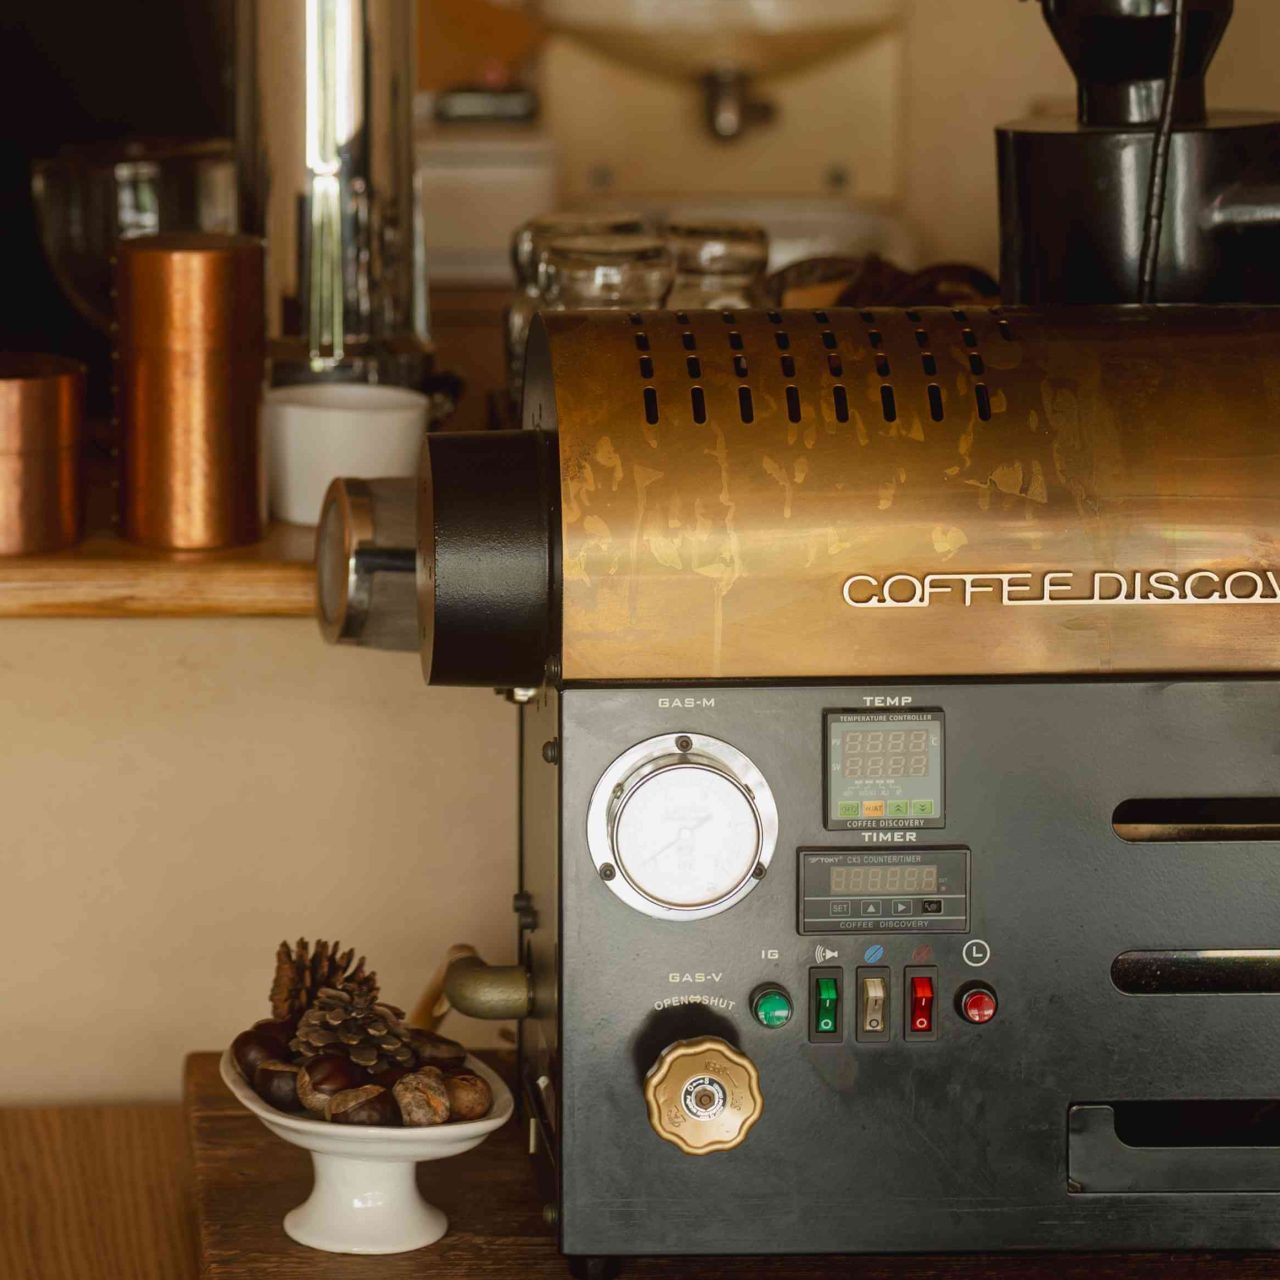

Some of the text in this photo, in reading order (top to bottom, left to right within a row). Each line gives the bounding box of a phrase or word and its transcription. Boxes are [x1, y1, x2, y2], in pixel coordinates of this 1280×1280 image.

[842, 572, 1074, 608] COFFEE
[658, 698, 715, 708] GAS-M
[863, 696, 913, 707] TEMP
[847, 819, 925, 828] COFFEE DISCOVERY
[861, 832, 917, 842] TIMER
[863, 855, 921, 864] COUNTER/TIMER
[832, 903, 848, 913] SET
[839, 920, 929, 929] COFFEE DISCOVERY
[761, 949, 780, 959] IG
[668, 972, 723, 983] GAS-V
[654, 995, 736, 1011] OPEN SHUT
